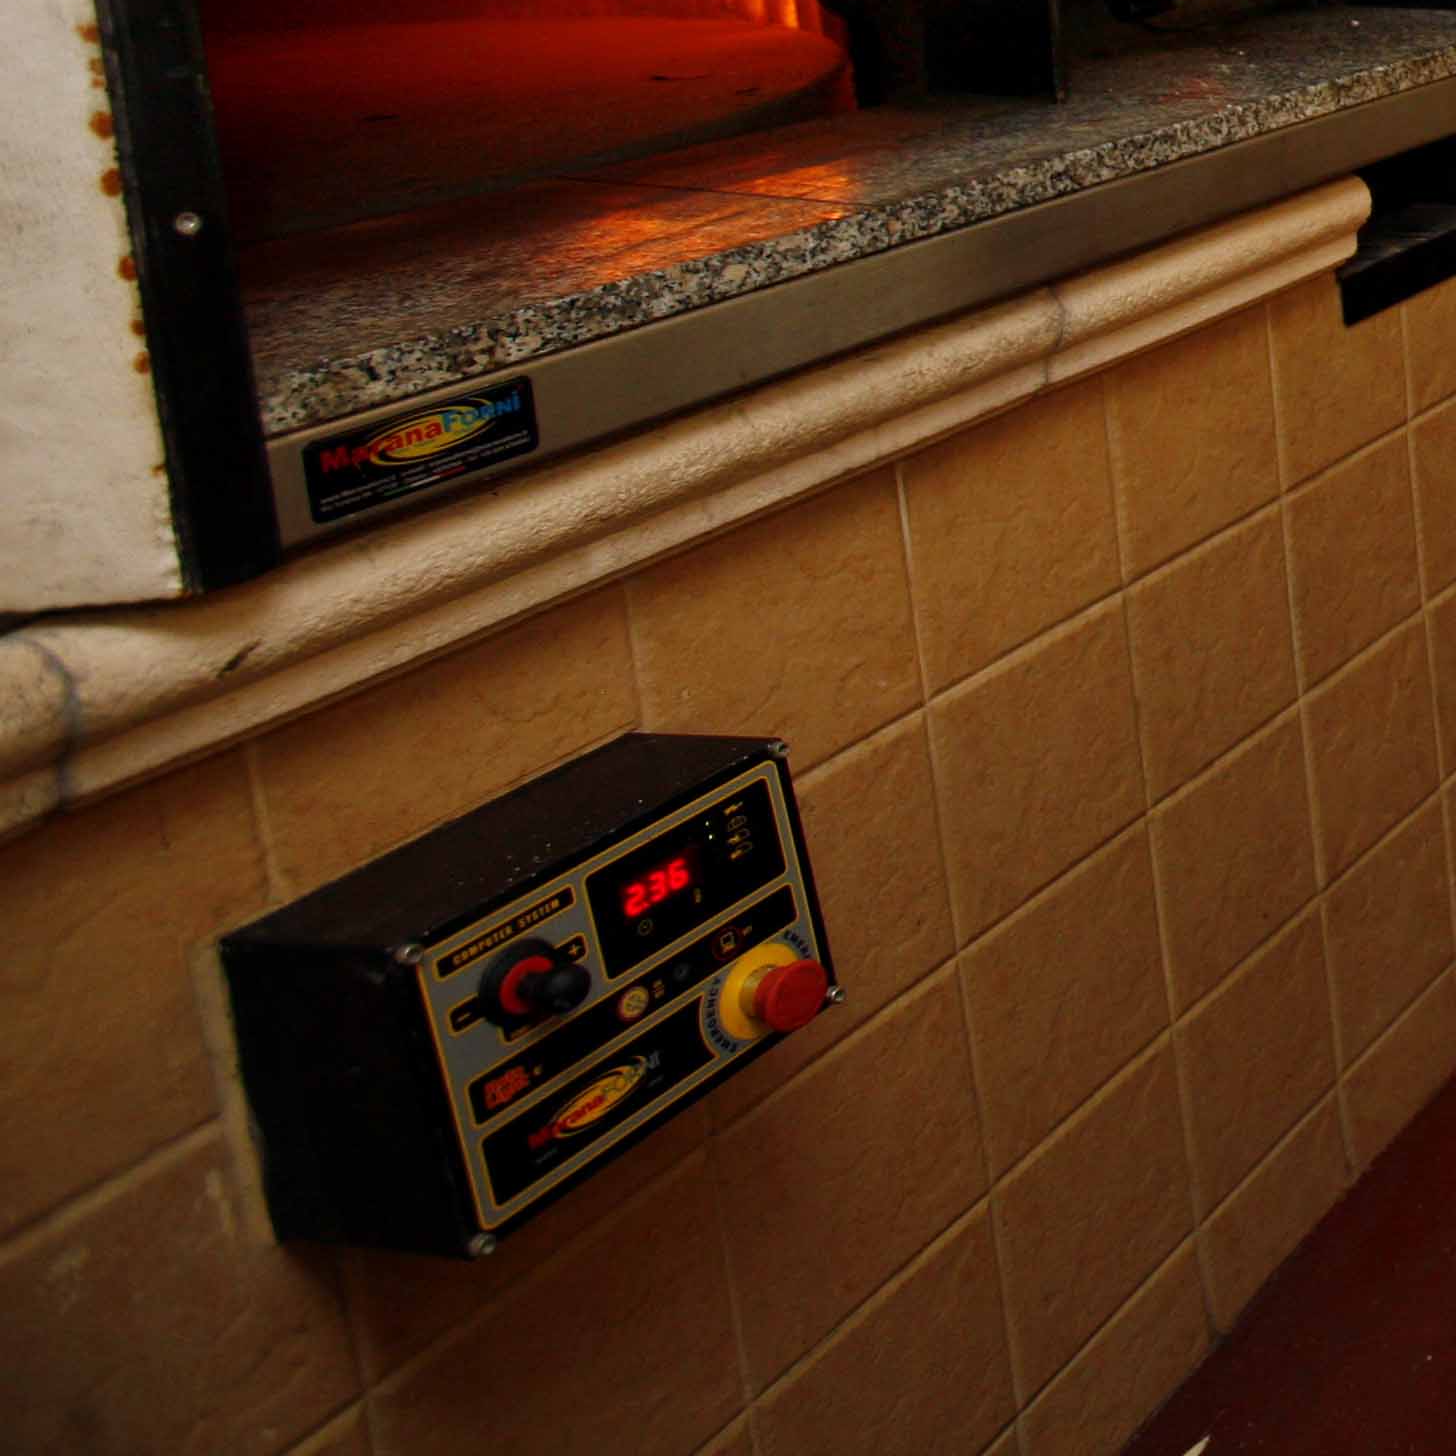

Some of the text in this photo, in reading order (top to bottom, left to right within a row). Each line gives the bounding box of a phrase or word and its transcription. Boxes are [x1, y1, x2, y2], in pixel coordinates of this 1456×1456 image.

[623, 856, 689, 919] 236
[451, 898, 561, 967] COMPUTER SYSTEM
